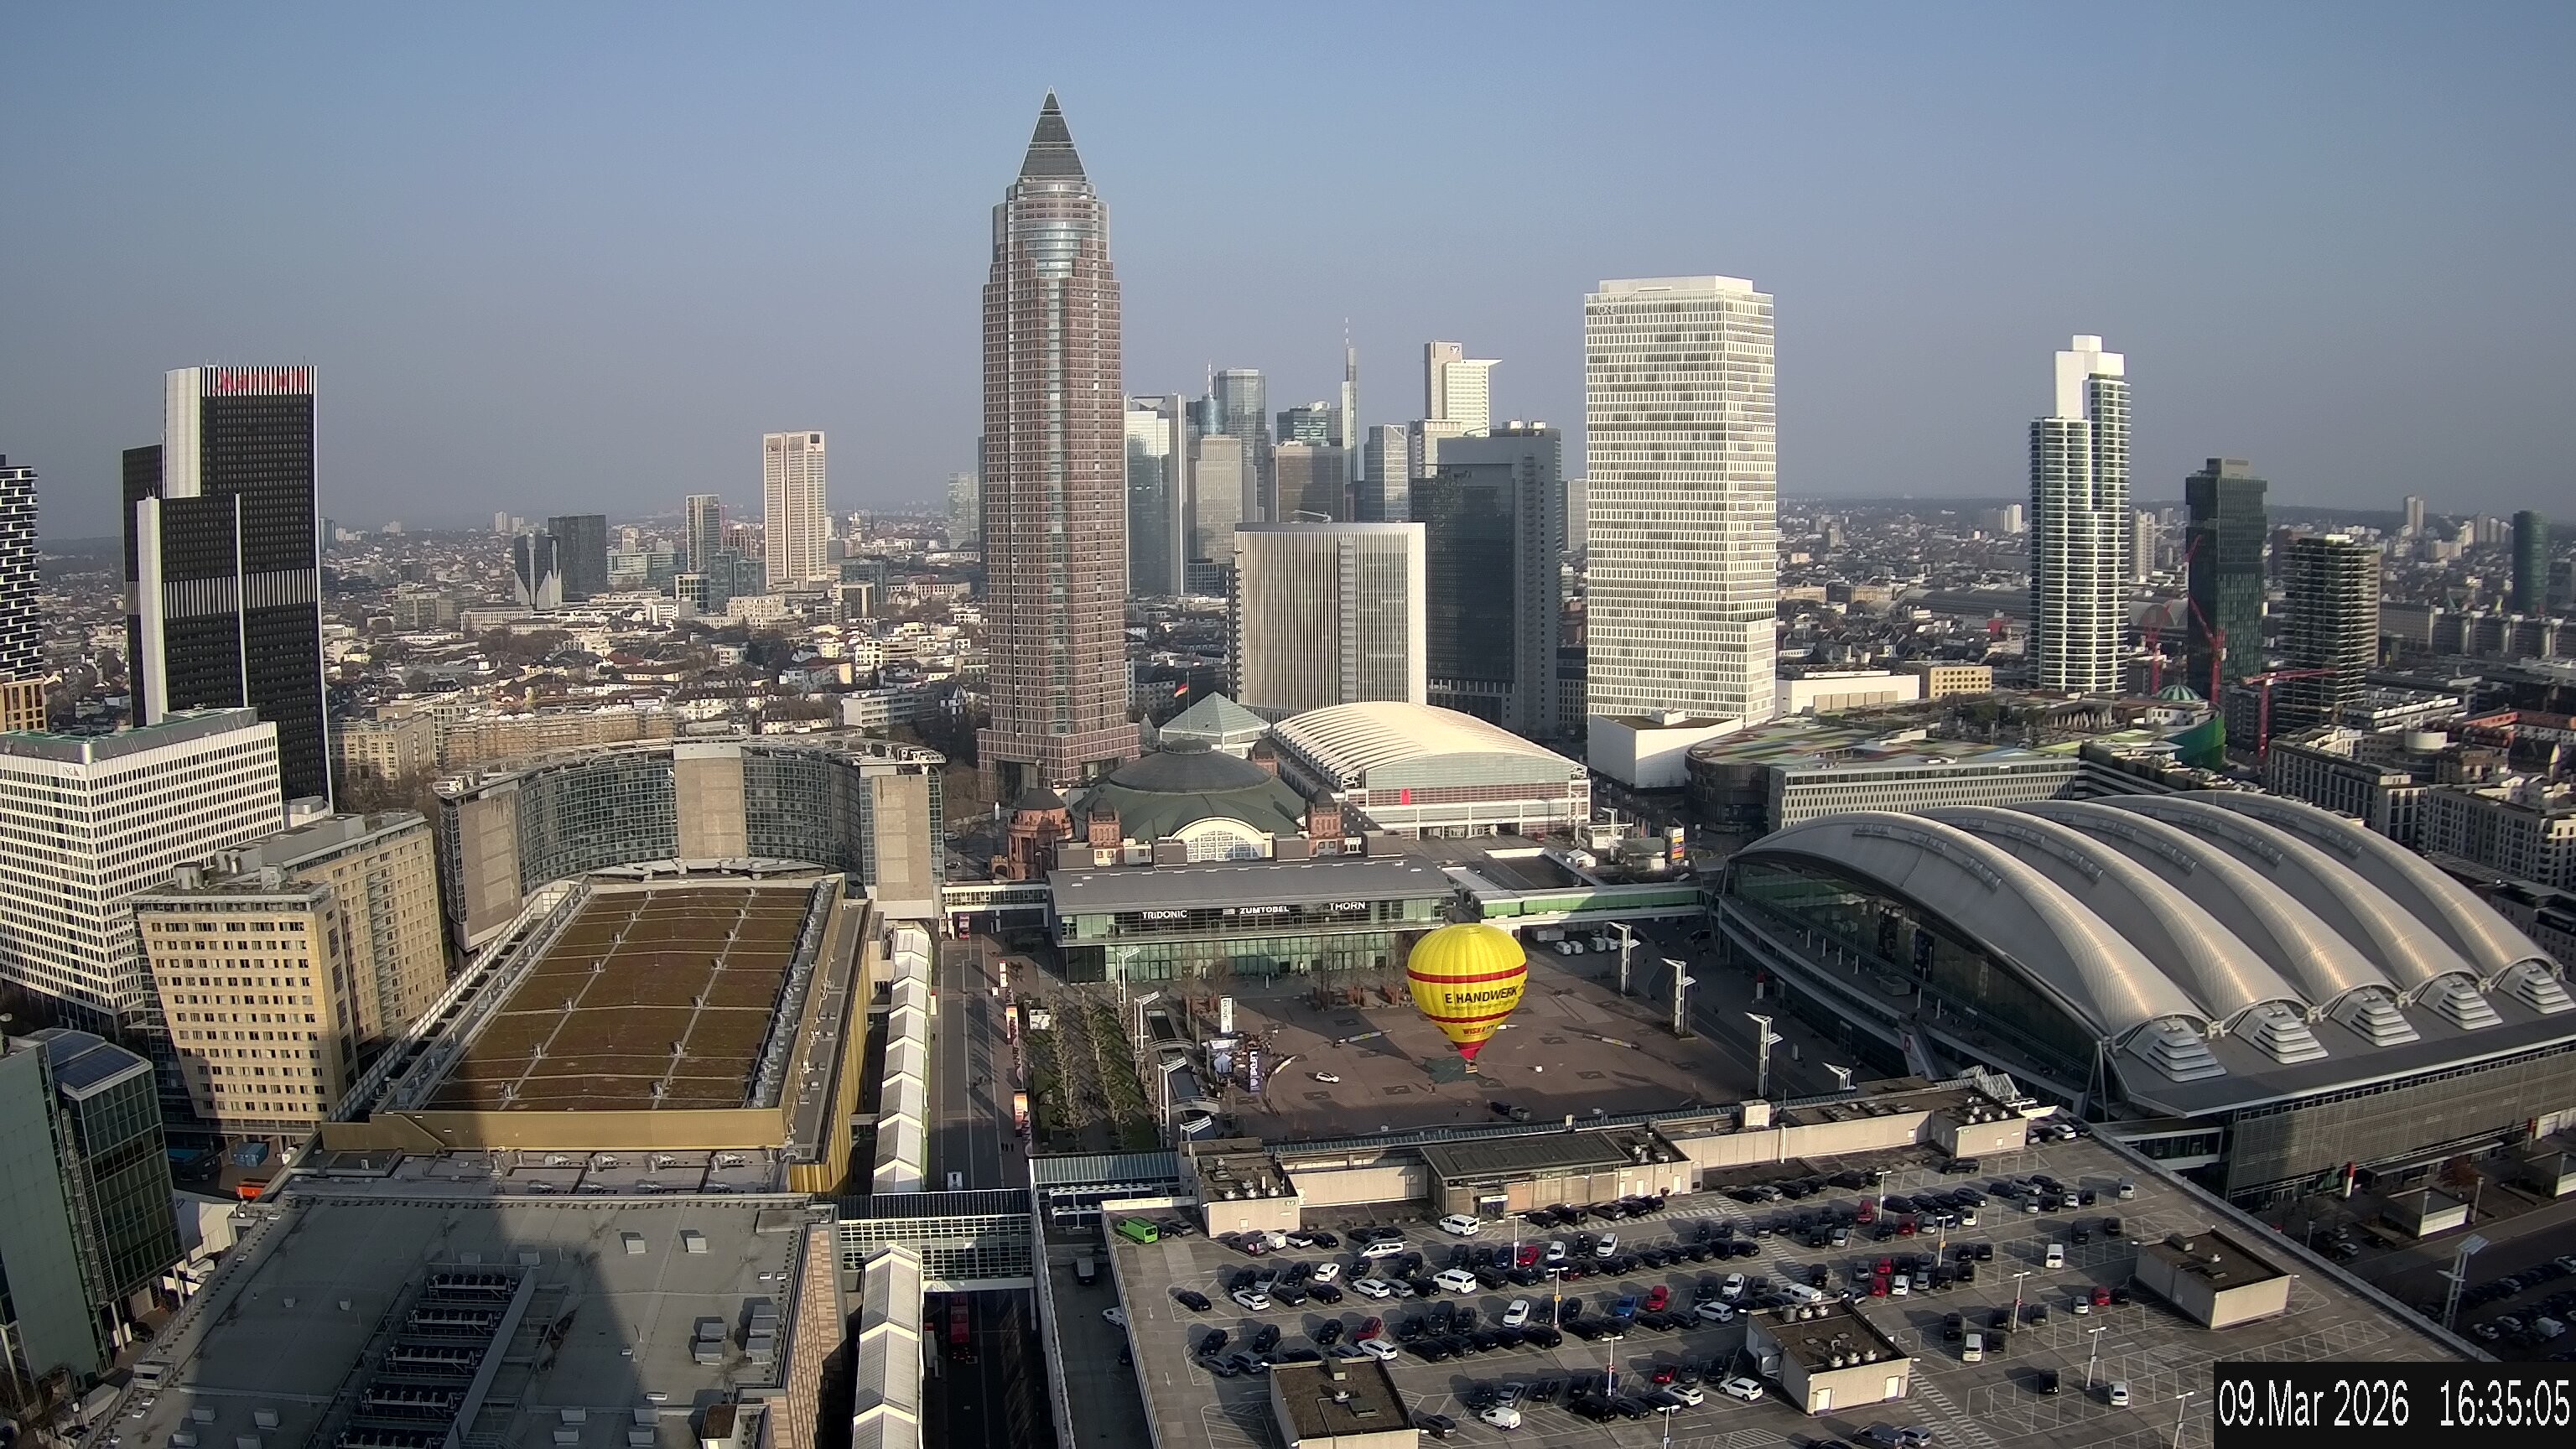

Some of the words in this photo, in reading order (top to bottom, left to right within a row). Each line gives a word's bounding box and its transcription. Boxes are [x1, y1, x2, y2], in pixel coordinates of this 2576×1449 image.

[212, 369, 304, 392] Marriott
[1239, 905, 1290, 915] ZUMTOBEL
[1329, 901, 1366, 911] THORN
[1142, 909, 1187, 920] TRIDONIC
[1456, 984, 1519, 1004] HANDWERK
